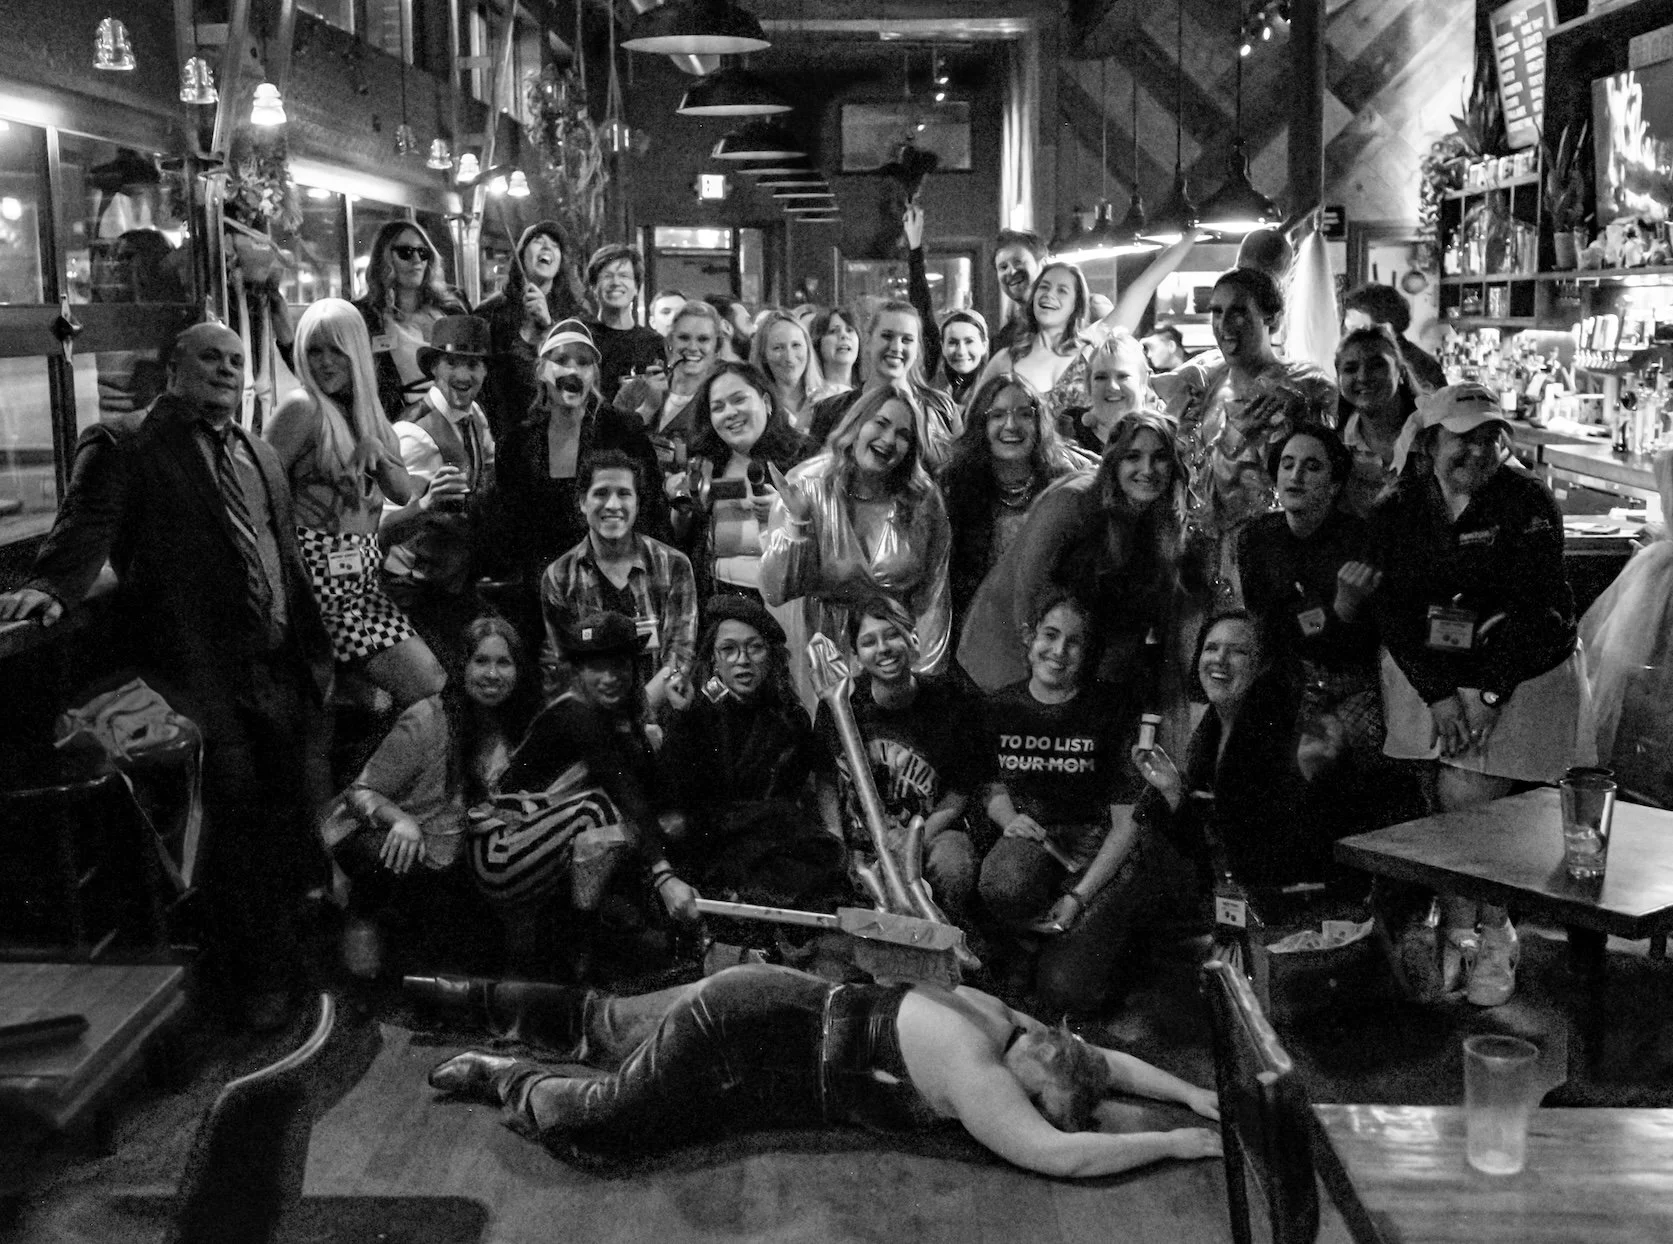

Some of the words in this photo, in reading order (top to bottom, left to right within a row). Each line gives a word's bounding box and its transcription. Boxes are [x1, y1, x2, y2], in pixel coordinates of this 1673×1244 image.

[1000, 735, 1022, 749] TO
[1025, 736, 1051, 750] DO
[998, 754, 1044, 771] YOUR
[1048, 757, 1095, 773] MOM
